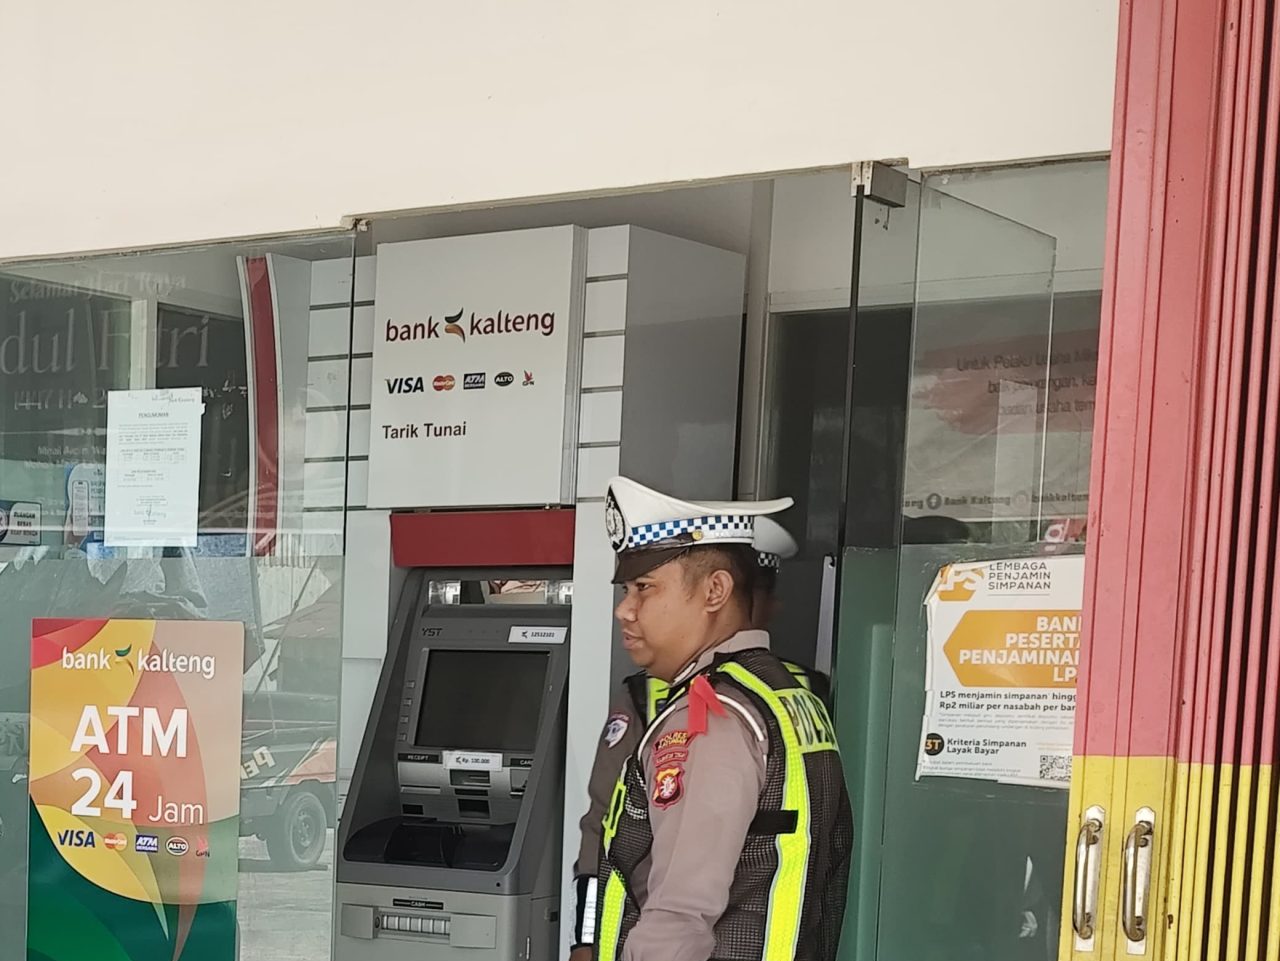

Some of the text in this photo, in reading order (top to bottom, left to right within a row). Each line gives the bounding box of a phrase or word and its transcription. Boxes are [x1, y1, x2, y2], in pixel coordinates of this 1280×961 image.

[385, 309, 555, 342] bank kalteng
[98, 308, 210, 371] Ftri
[385, 377, 424, 395] VISA
[382, 421, 467, 439] Tarik Tunai
[989, 562, 1047, 571] LEMBAGA
[988, 572, 1051, 580] PENJAMIN
[988, 581, 1051, 590] SIMPANAN
[1037, 616, 1081, 631] BAN
[1006, 632, 1080, 648] PESERT
[62, 647, 216, 679] bank kalteng
[1053, 667, 1077, 682] LP
[958, 691, 1002, 700] menjamin
[939, 702, 956, 710] Rp2
[959, 702, 984, 710] miliar
[986, 703, 1001, 711] per
[1004, 703, 1040, 711] nasabah
[1043, 704, 1058, 712] per
[71, 705, 188, 758] ATM
[947, 738, 980, 746] Kriteria
[983, 738, 1027, 748] Simpanan
[947, 746, 1000, 755] Layak Bayar
[71, 768, 204, 824] 24 Jam
[58, 829, 96, 848] VISA
[168, 842, 187, 850] ALTO
